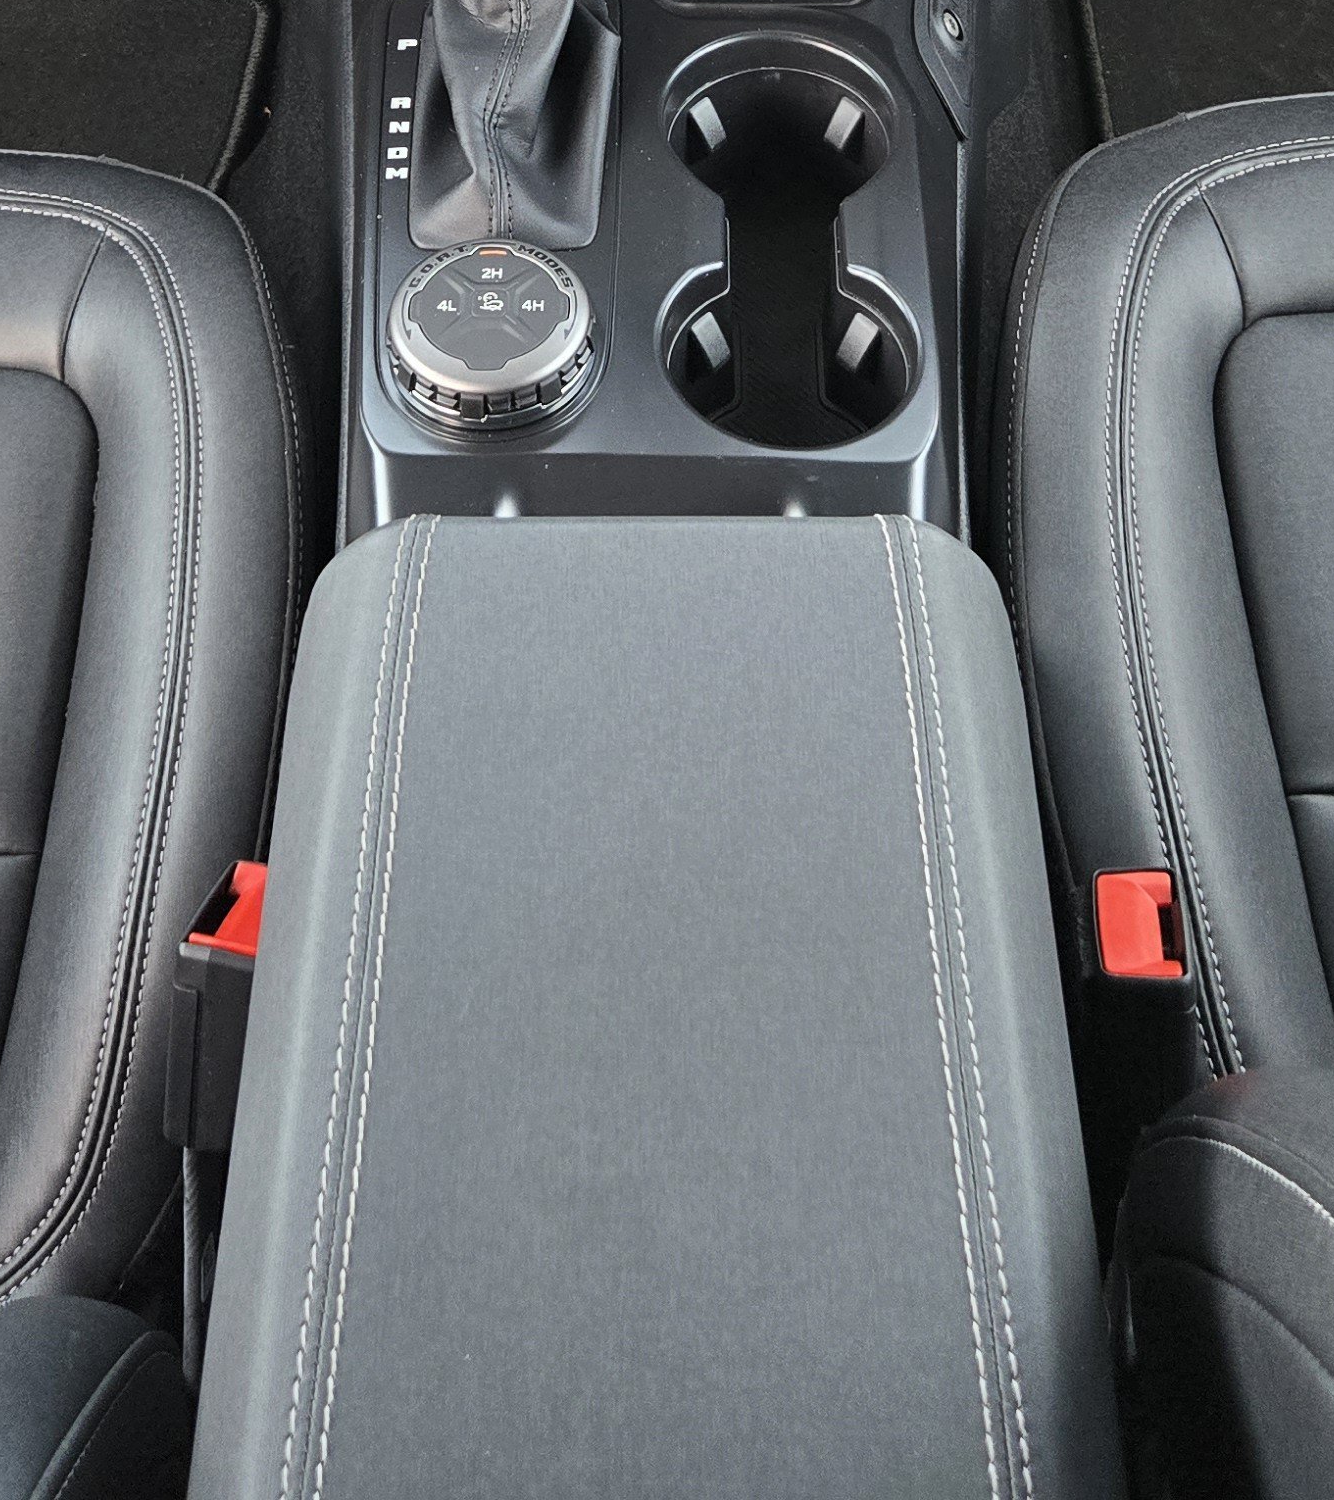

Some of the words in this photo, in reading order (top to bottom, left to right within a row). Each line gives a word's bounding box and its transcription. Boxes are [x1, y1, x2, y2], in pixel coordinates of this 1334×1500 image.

[397, 38, 418, 50] P
[388, 121, 410, 133] N
[386, 146, 408, 160] D
[386, 167, 408, 180] M
[518, 245, 574, 288] MODES
[481, 268, 503, 280] 2H
[436, 300, 457, 312] 4L
[521, 300, 545, 312] 4H
